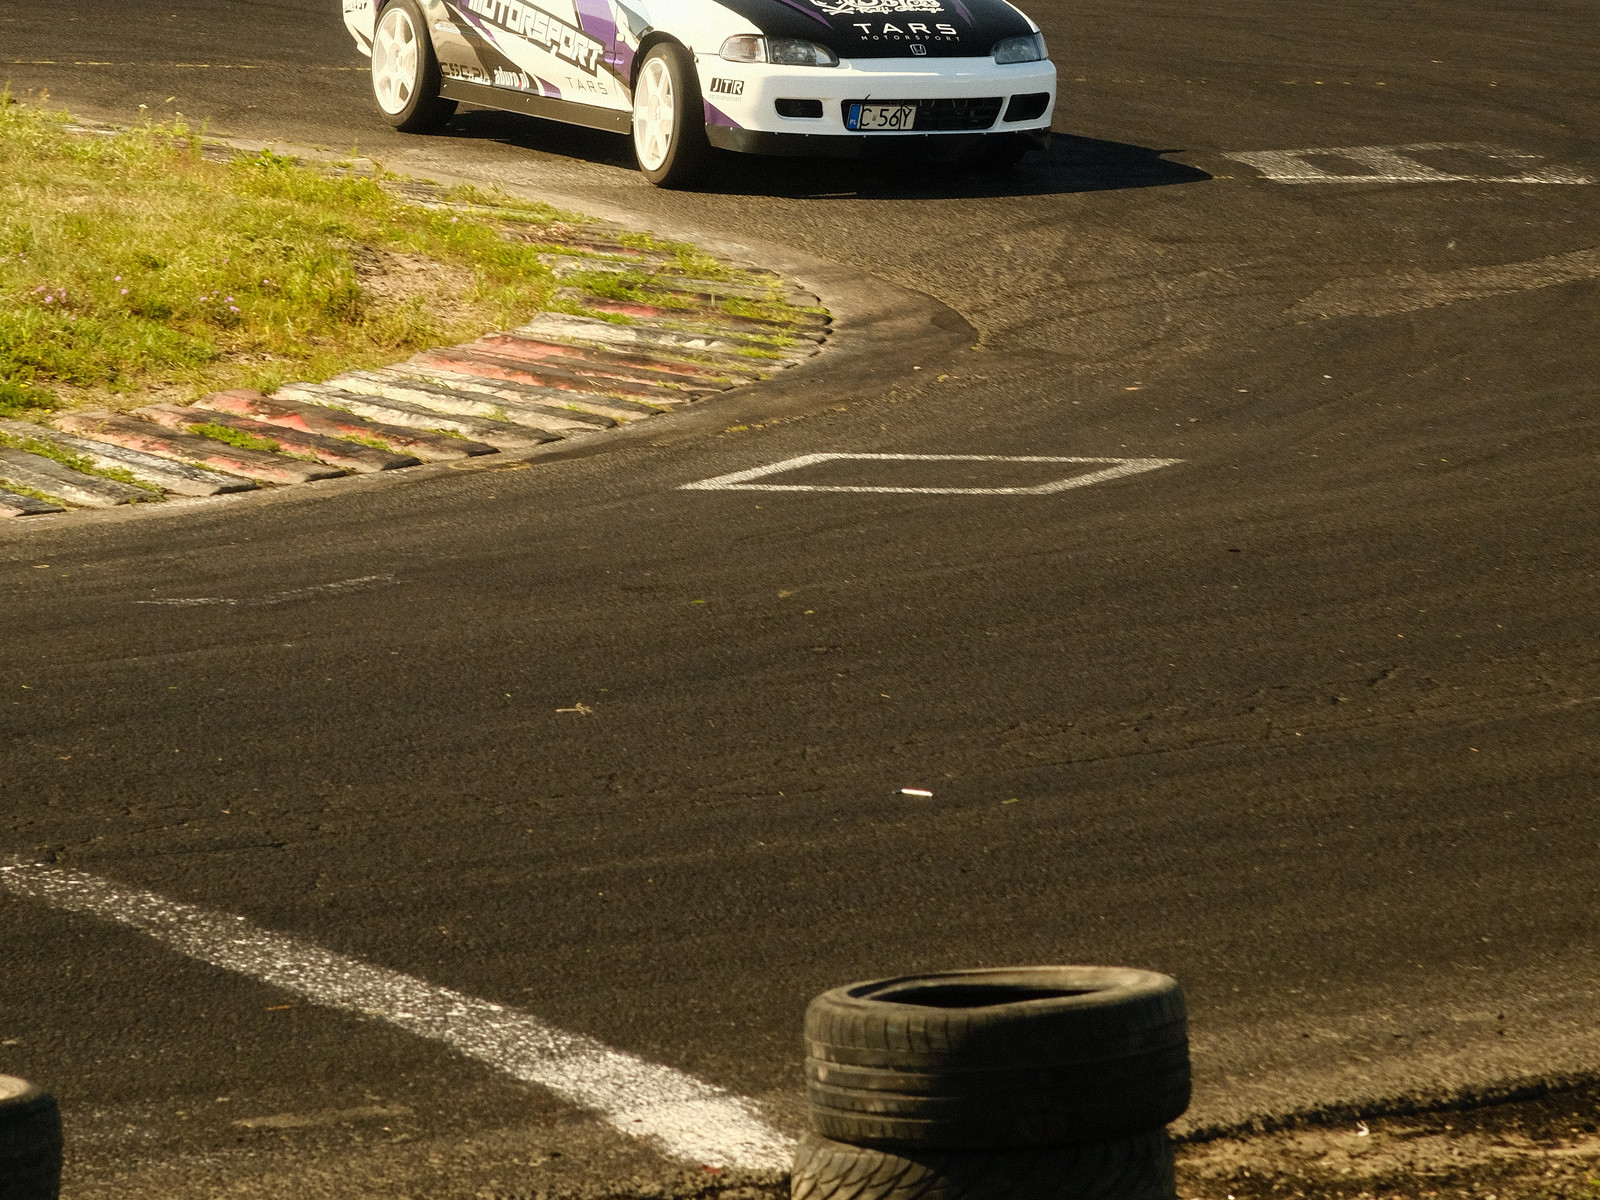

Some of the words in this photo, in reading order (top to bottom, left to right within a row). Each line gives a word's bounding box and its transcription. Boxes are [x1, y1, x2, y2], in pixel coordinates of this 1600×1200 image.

[853, 22, 957, 35] TARS
[493, 65, 530, 91] aduro.pl
[565, 76, 608, 95] TARS
[711, 78, 744, 95] JTR
[860, 108, 872, 128] C
